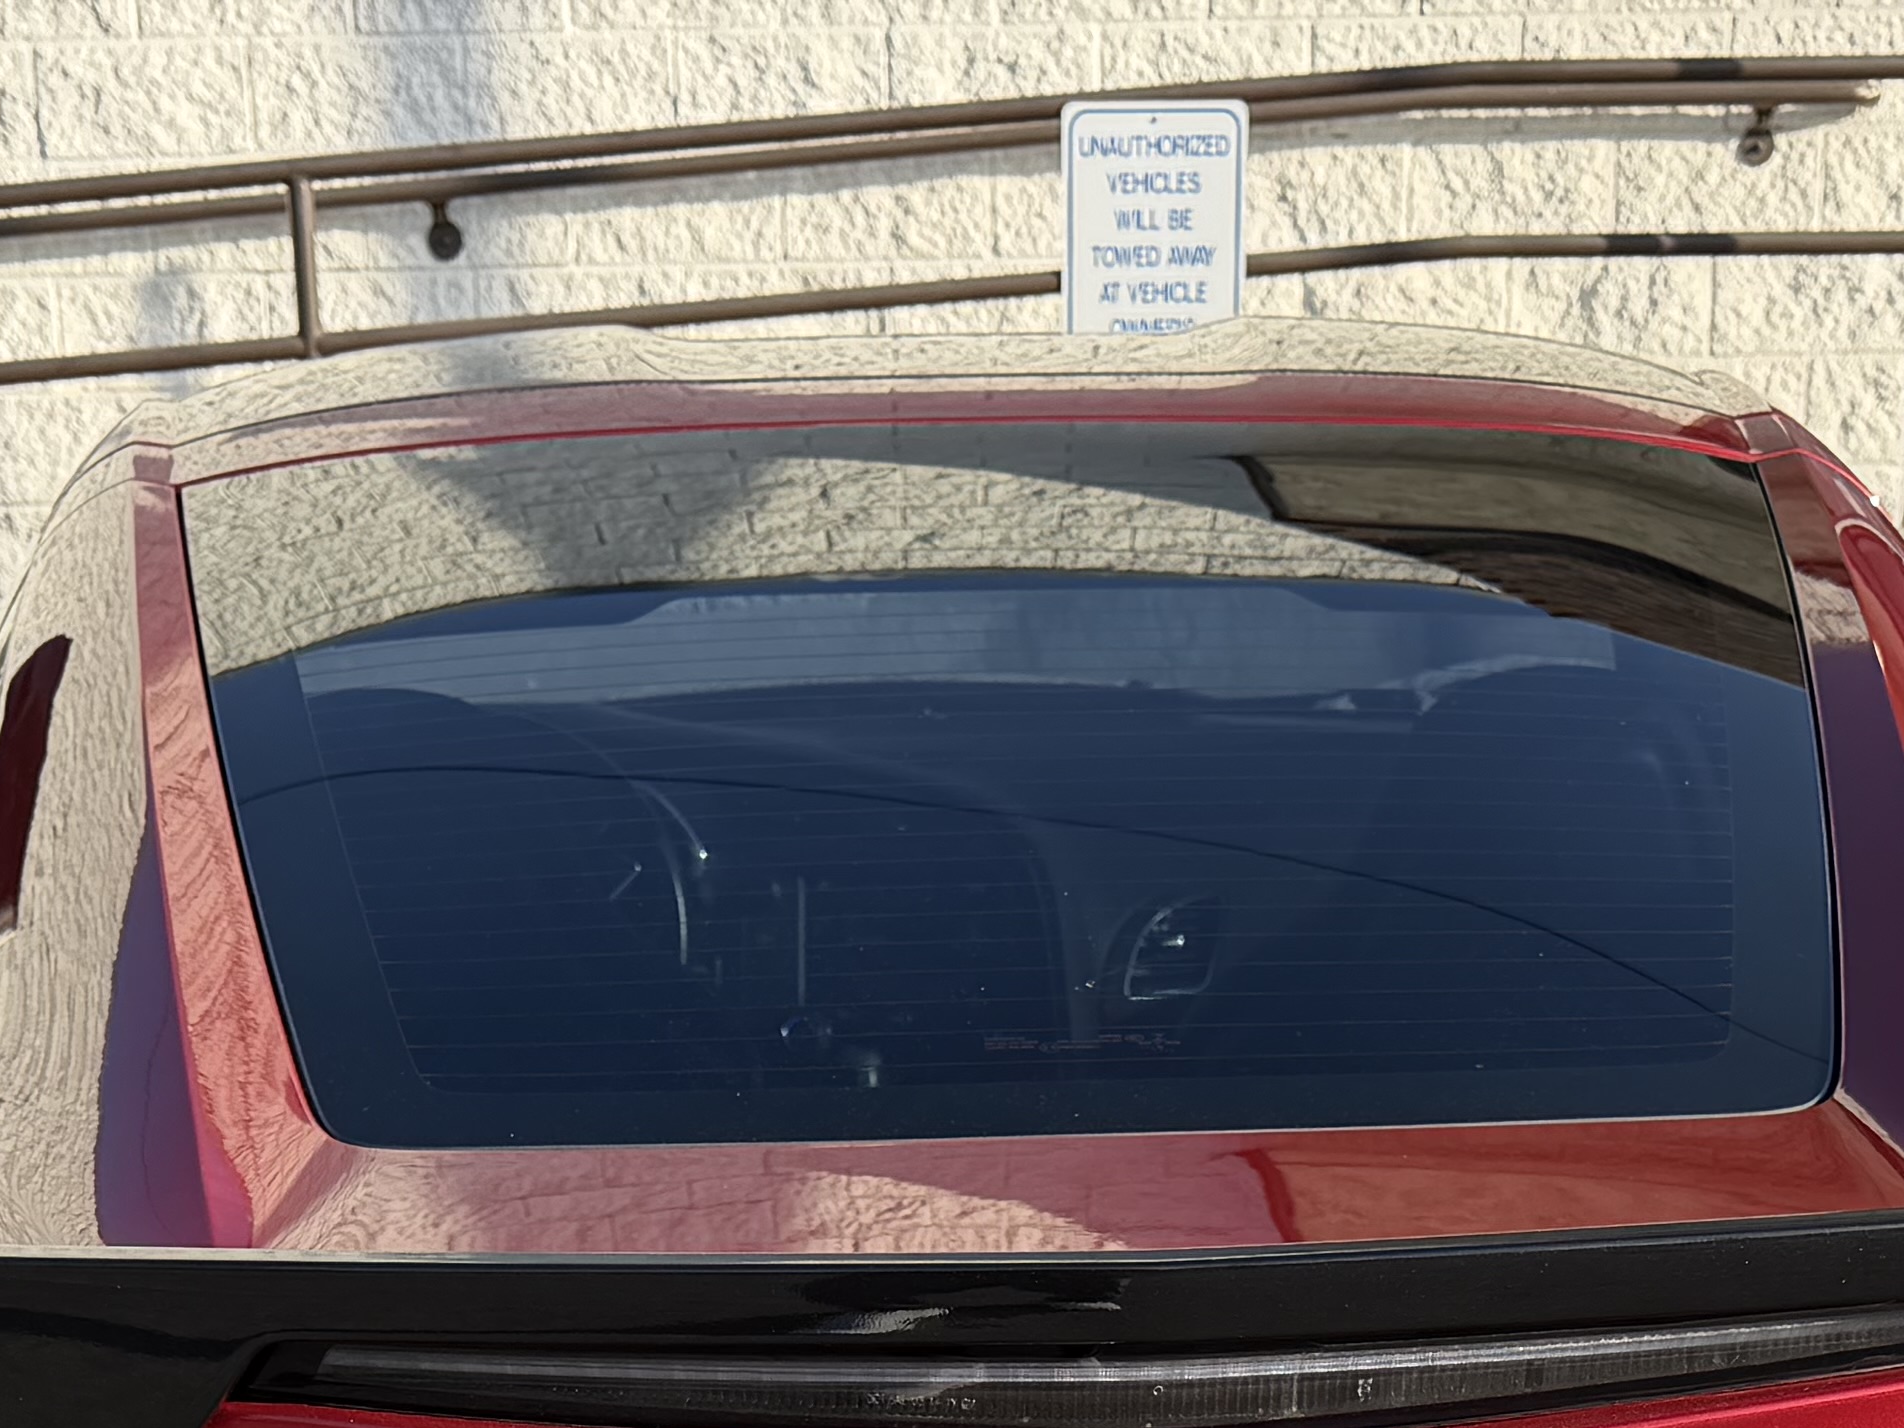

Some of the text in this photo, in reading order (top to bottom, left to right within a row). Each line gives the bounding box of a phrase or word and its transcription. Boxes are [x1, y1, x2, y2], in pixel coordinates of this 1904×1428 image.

[1078, 134, 1231, 157] UNAUTHORIZED
[1107, 172, 1202, 194] VEHICLES
[1114, 209, 1194, 231] WILL BE
[1092, 245, 1216, 268] TOWED AWAY
[1098, 281, 1208, 304] AT VEHICLE
